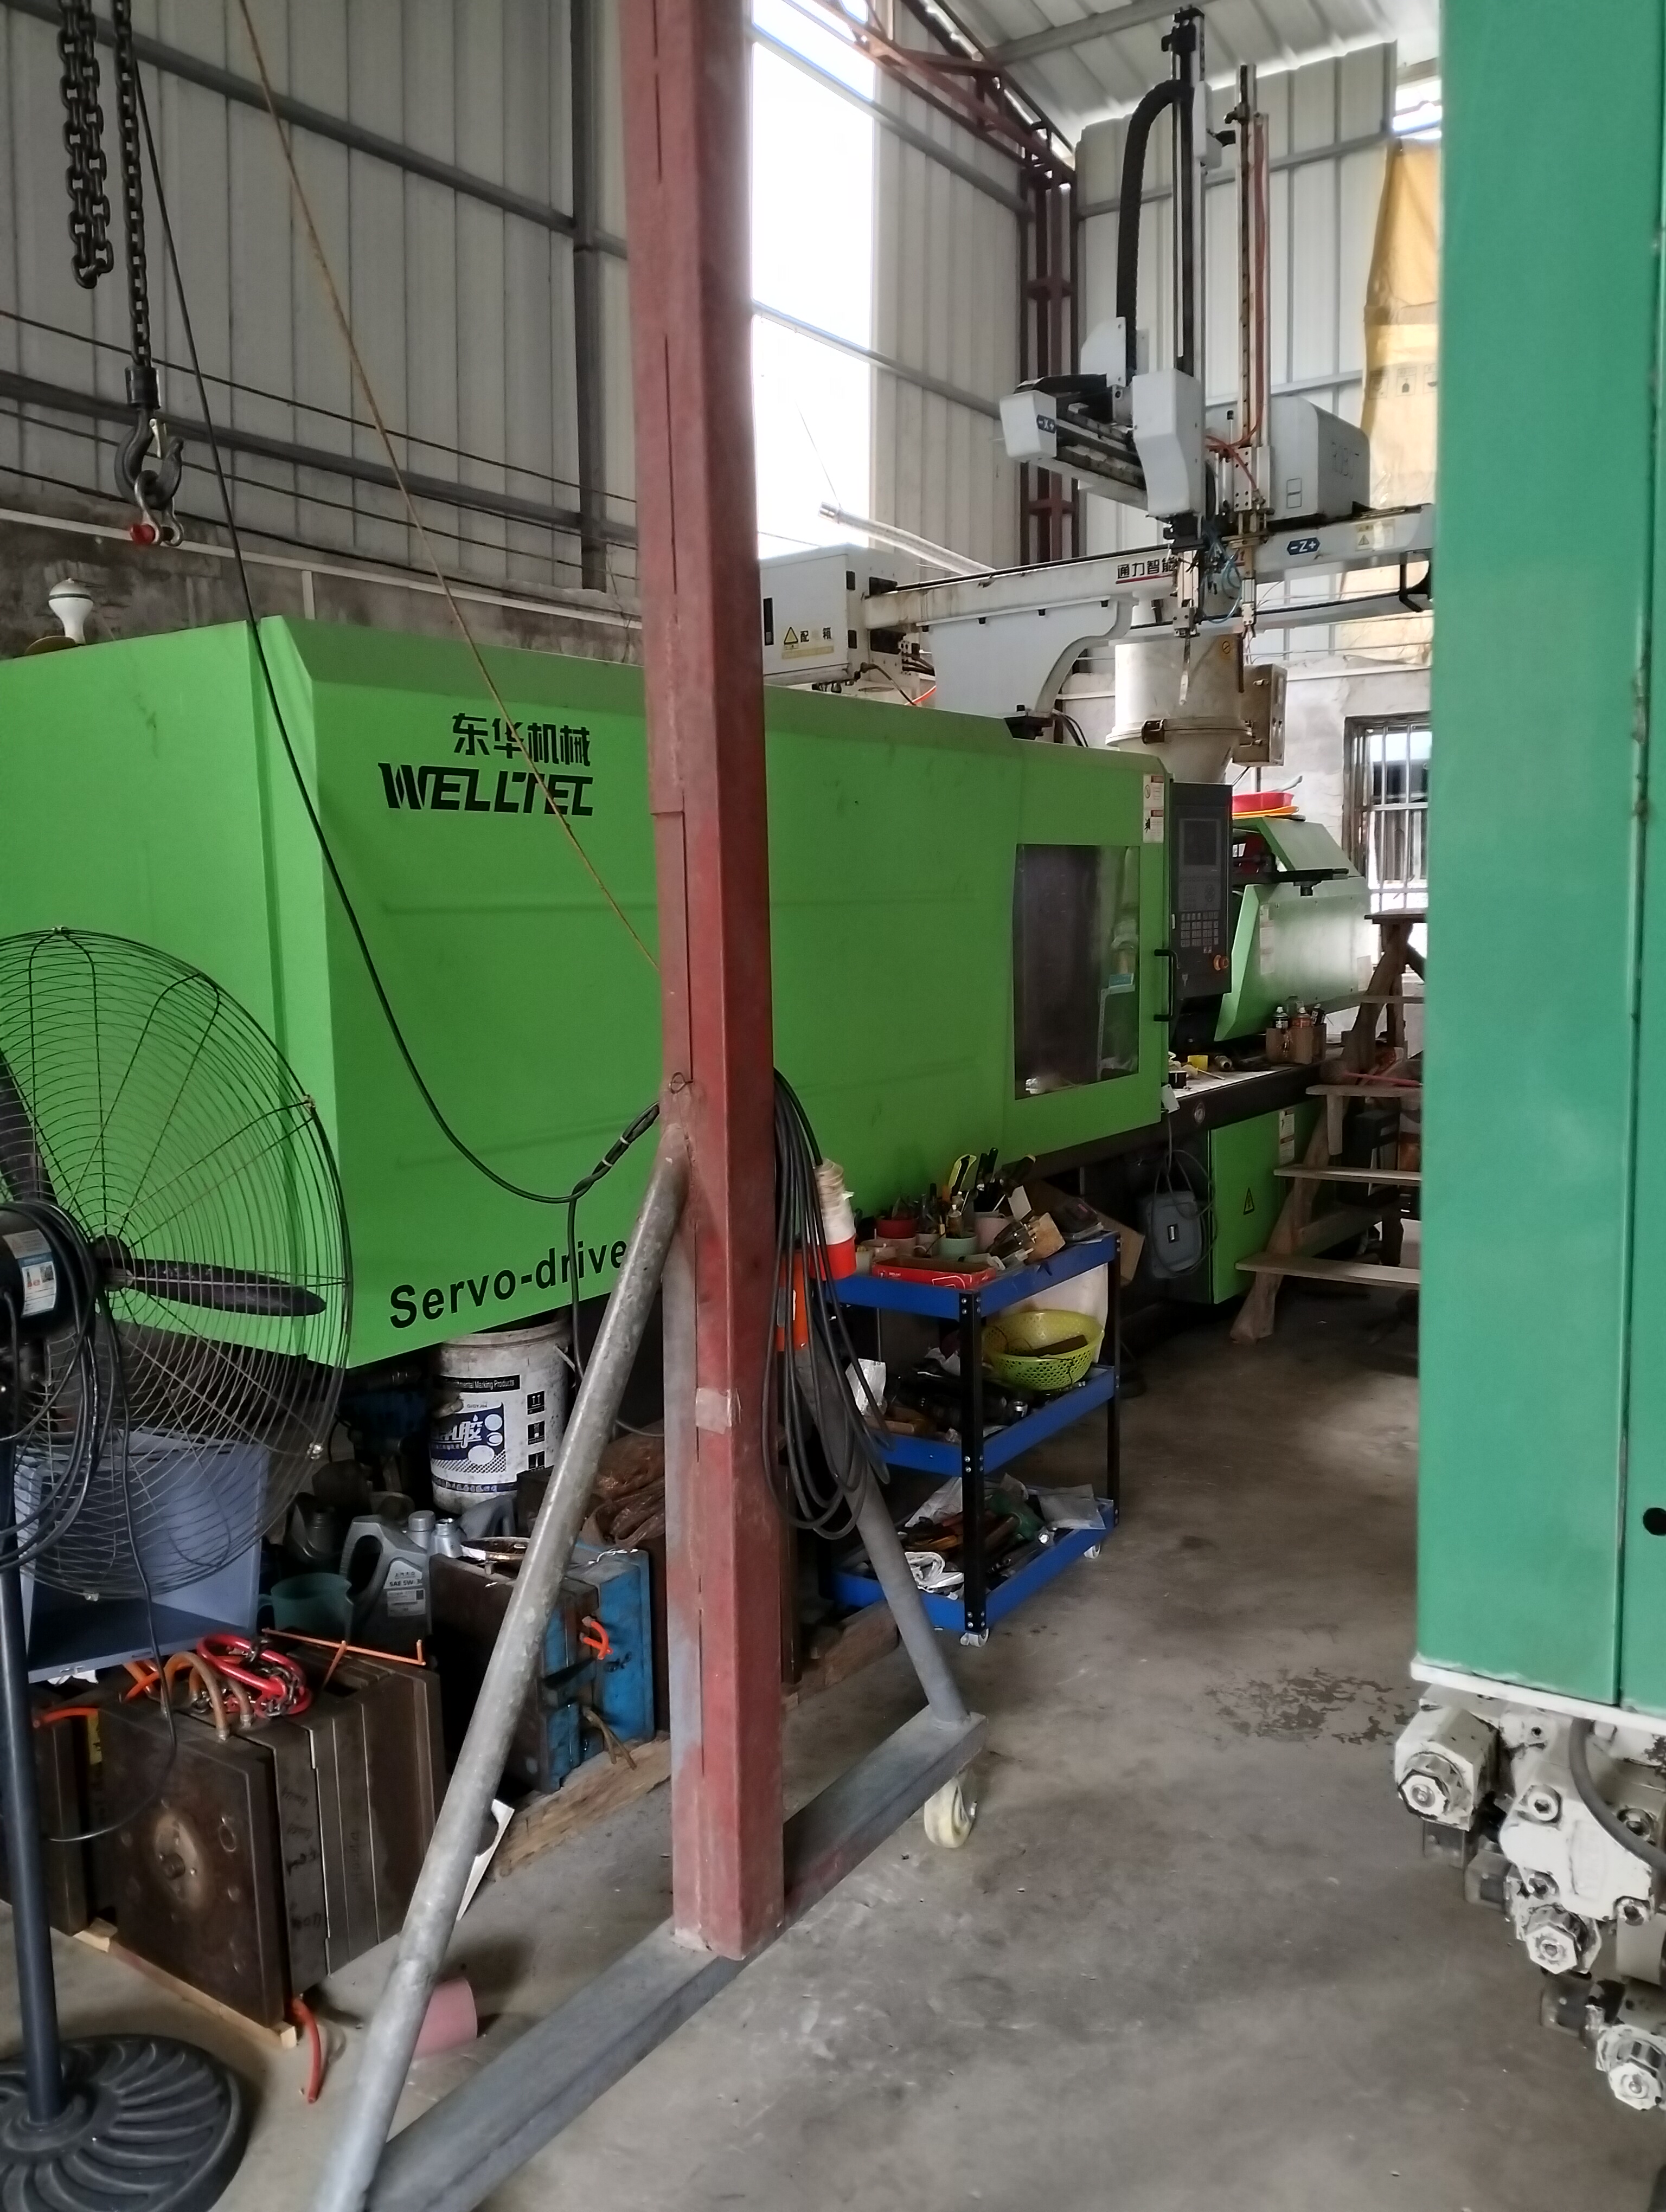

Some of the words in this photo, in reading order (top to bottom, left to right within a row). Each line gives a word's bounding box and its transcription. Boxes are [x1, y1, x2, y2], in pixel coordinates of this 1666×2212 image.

[1290, 540, 1316, 553] -Z+
[1117, 557, 1177, 579] 通力智能
[452, 712, 591, 767] 东华机械
[377, 762, 594, 816] WELLTEC
[389, 1240, 627, 1329] Servo-drive
[494, 1379, 515, 1388] Products
